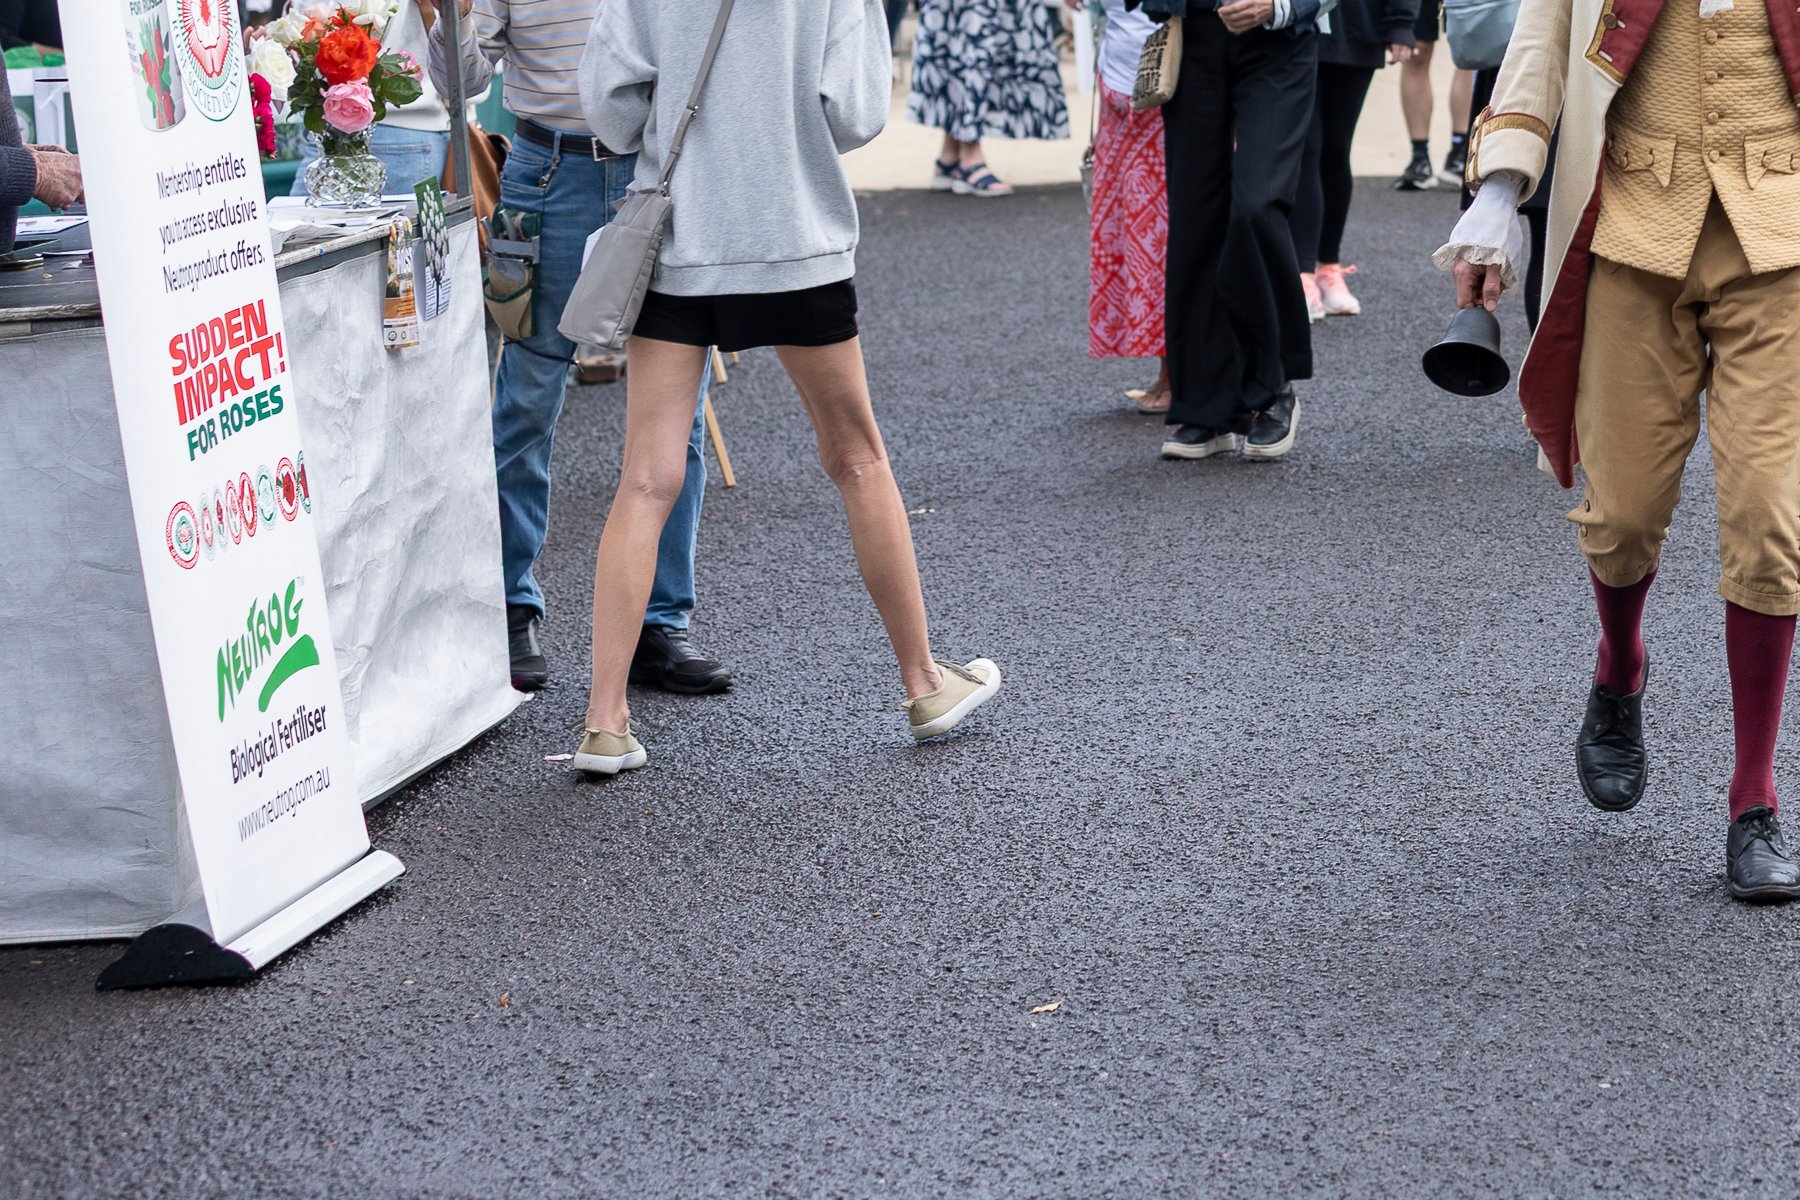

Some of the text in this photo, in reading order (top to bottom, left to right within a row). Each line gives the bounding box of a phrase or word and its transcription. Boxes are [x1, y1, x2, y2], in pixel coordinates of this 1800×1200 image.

[204, 152, 247, 187] entitles
[183, 210, 207, 239] access
[207, 196, 258, 231] exclusive
[194, 249, 230, 288] product
[230, 239, 266, 271] offers.
[168, 298, 269, 377] SUDDEN
[173, 331, 287, 427] IMPACT!
[187, 384, 284, 462] FOR ROSES
[216, 577, 305, 723] NEUTROG
[230, 704, 328, 785] Biological Fertiliser
[237, 765, 331, 843] www.neutrog.com.au
